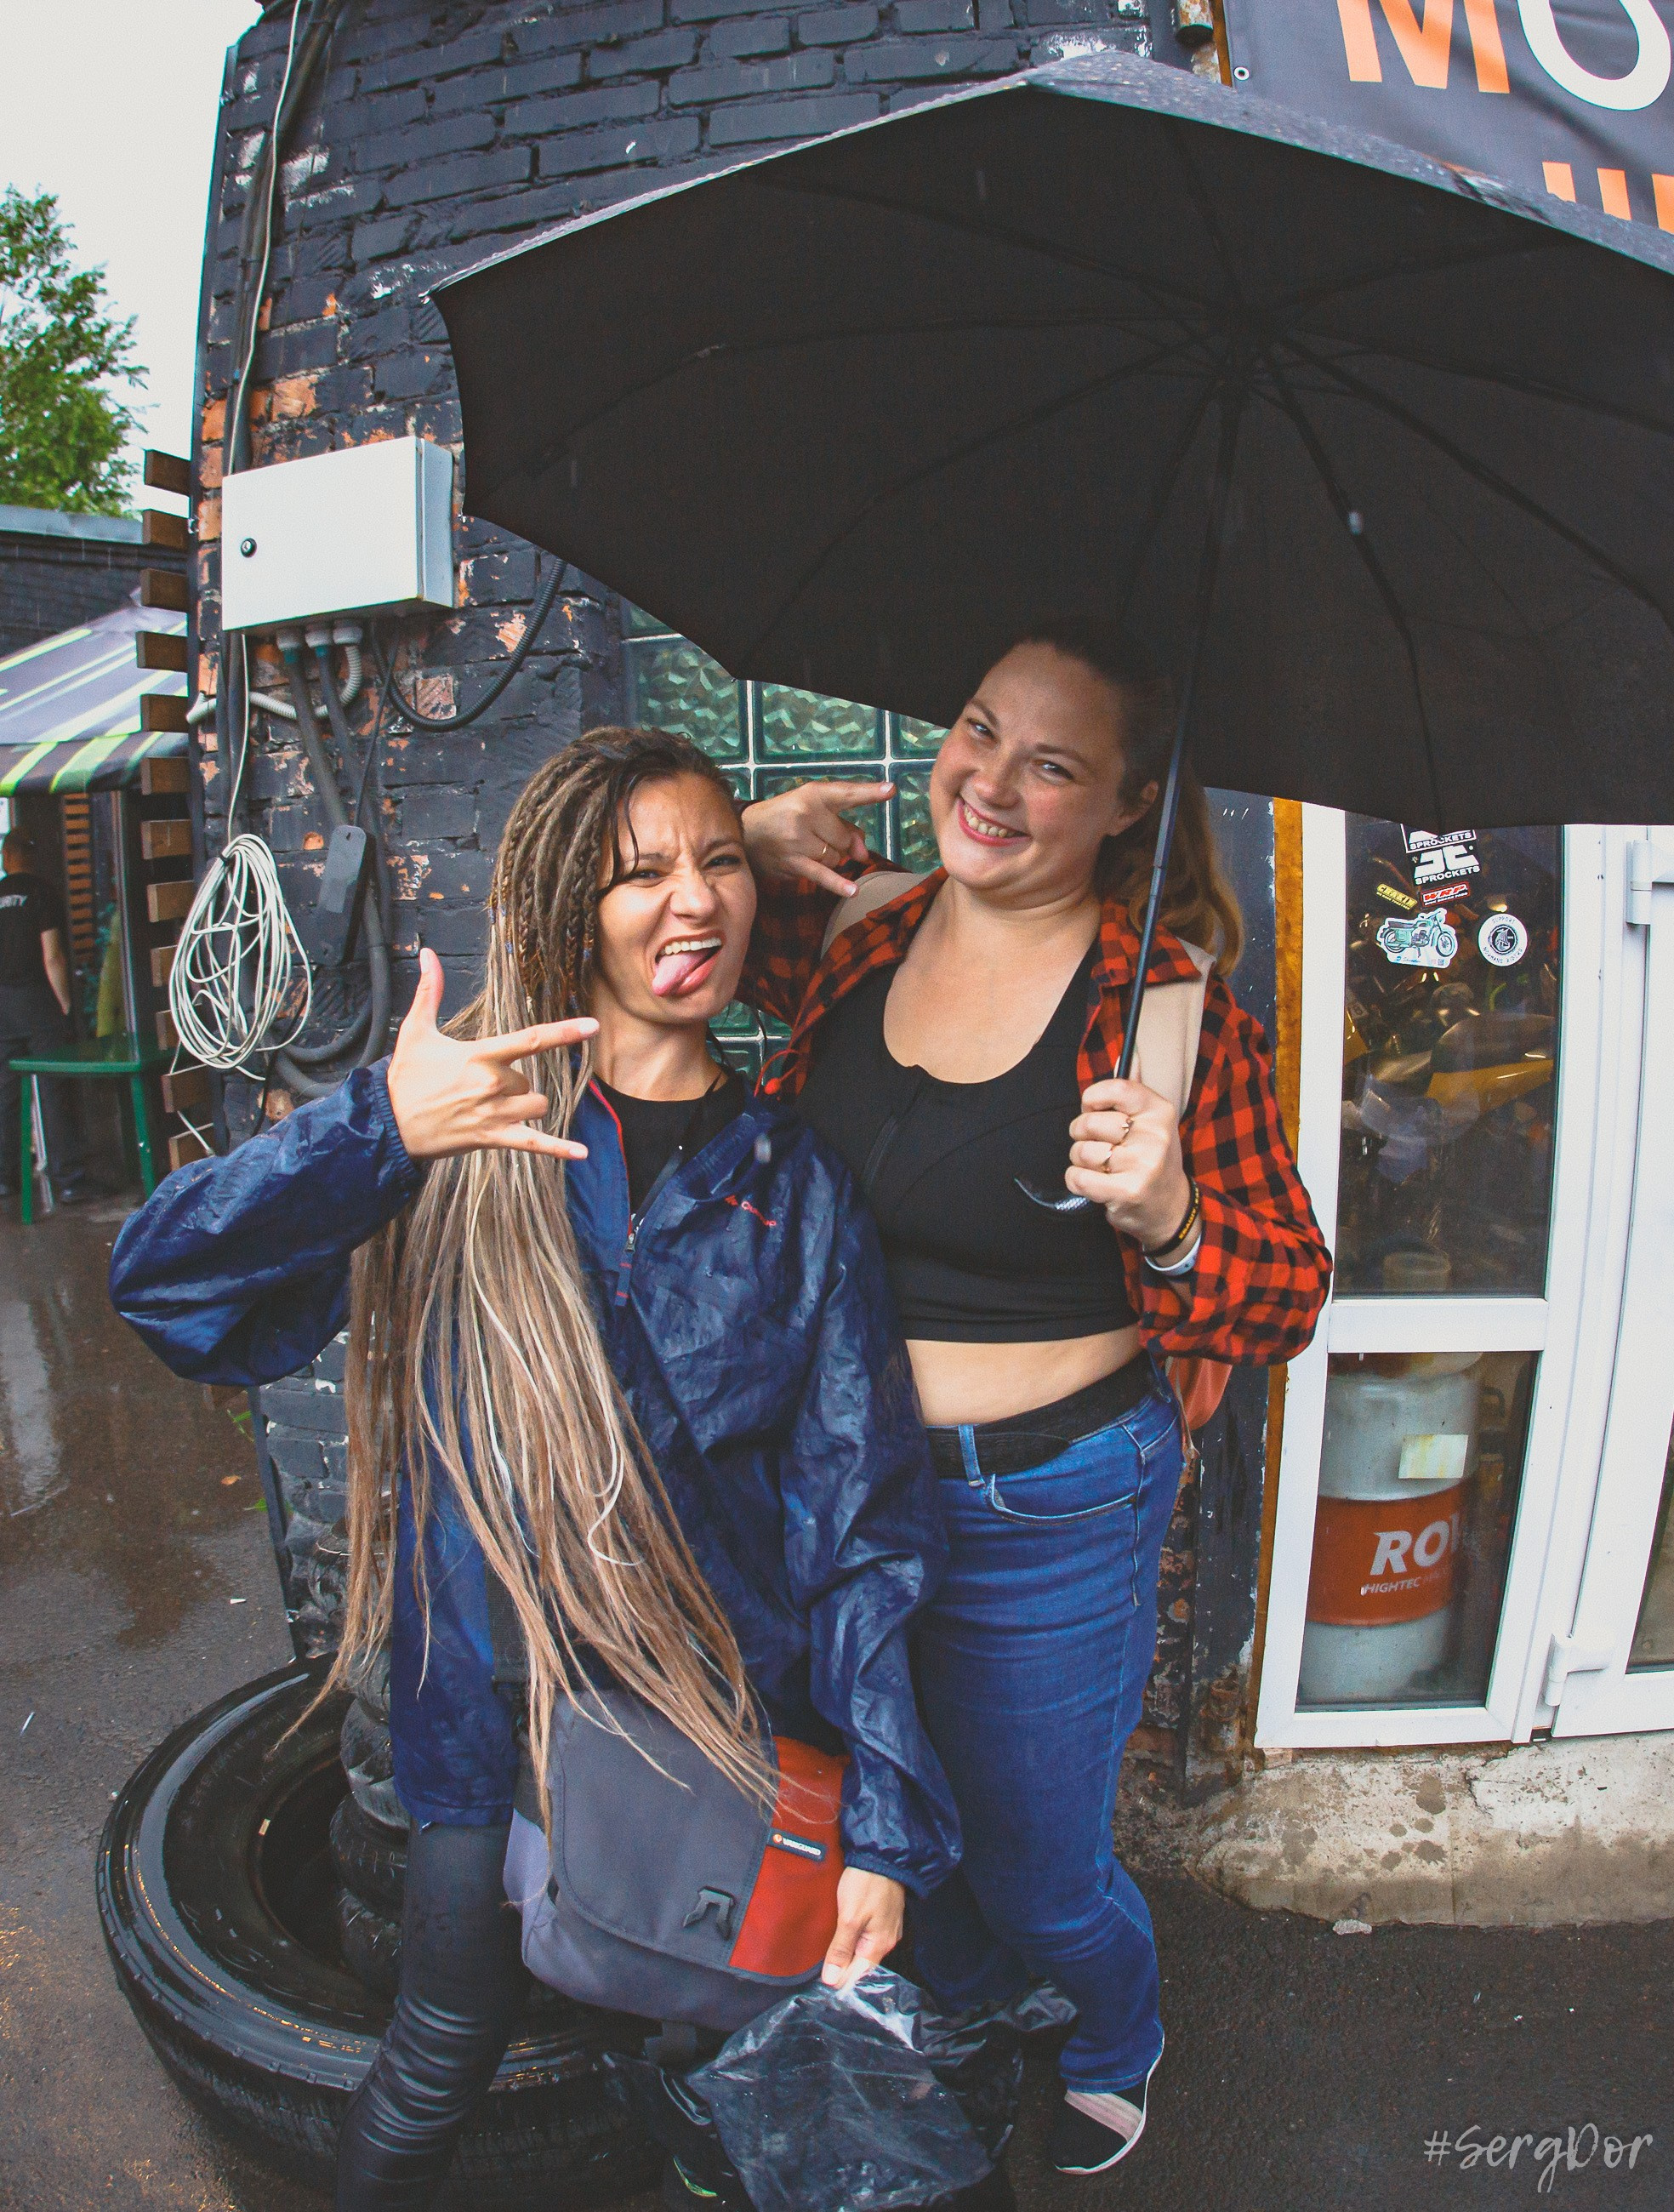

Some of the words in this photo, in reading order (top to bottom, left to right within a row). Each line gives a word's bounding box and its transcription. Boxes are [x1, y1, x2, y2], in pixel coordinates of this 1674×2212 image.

[1409, 832, 1472, 850] SPROCKETS
[1415, 865, 1481, 885] SPROCKETS
[1424, 885, 1466, 902] WRP
[1363, 1576, 1421, 1594] HIGHTEC
